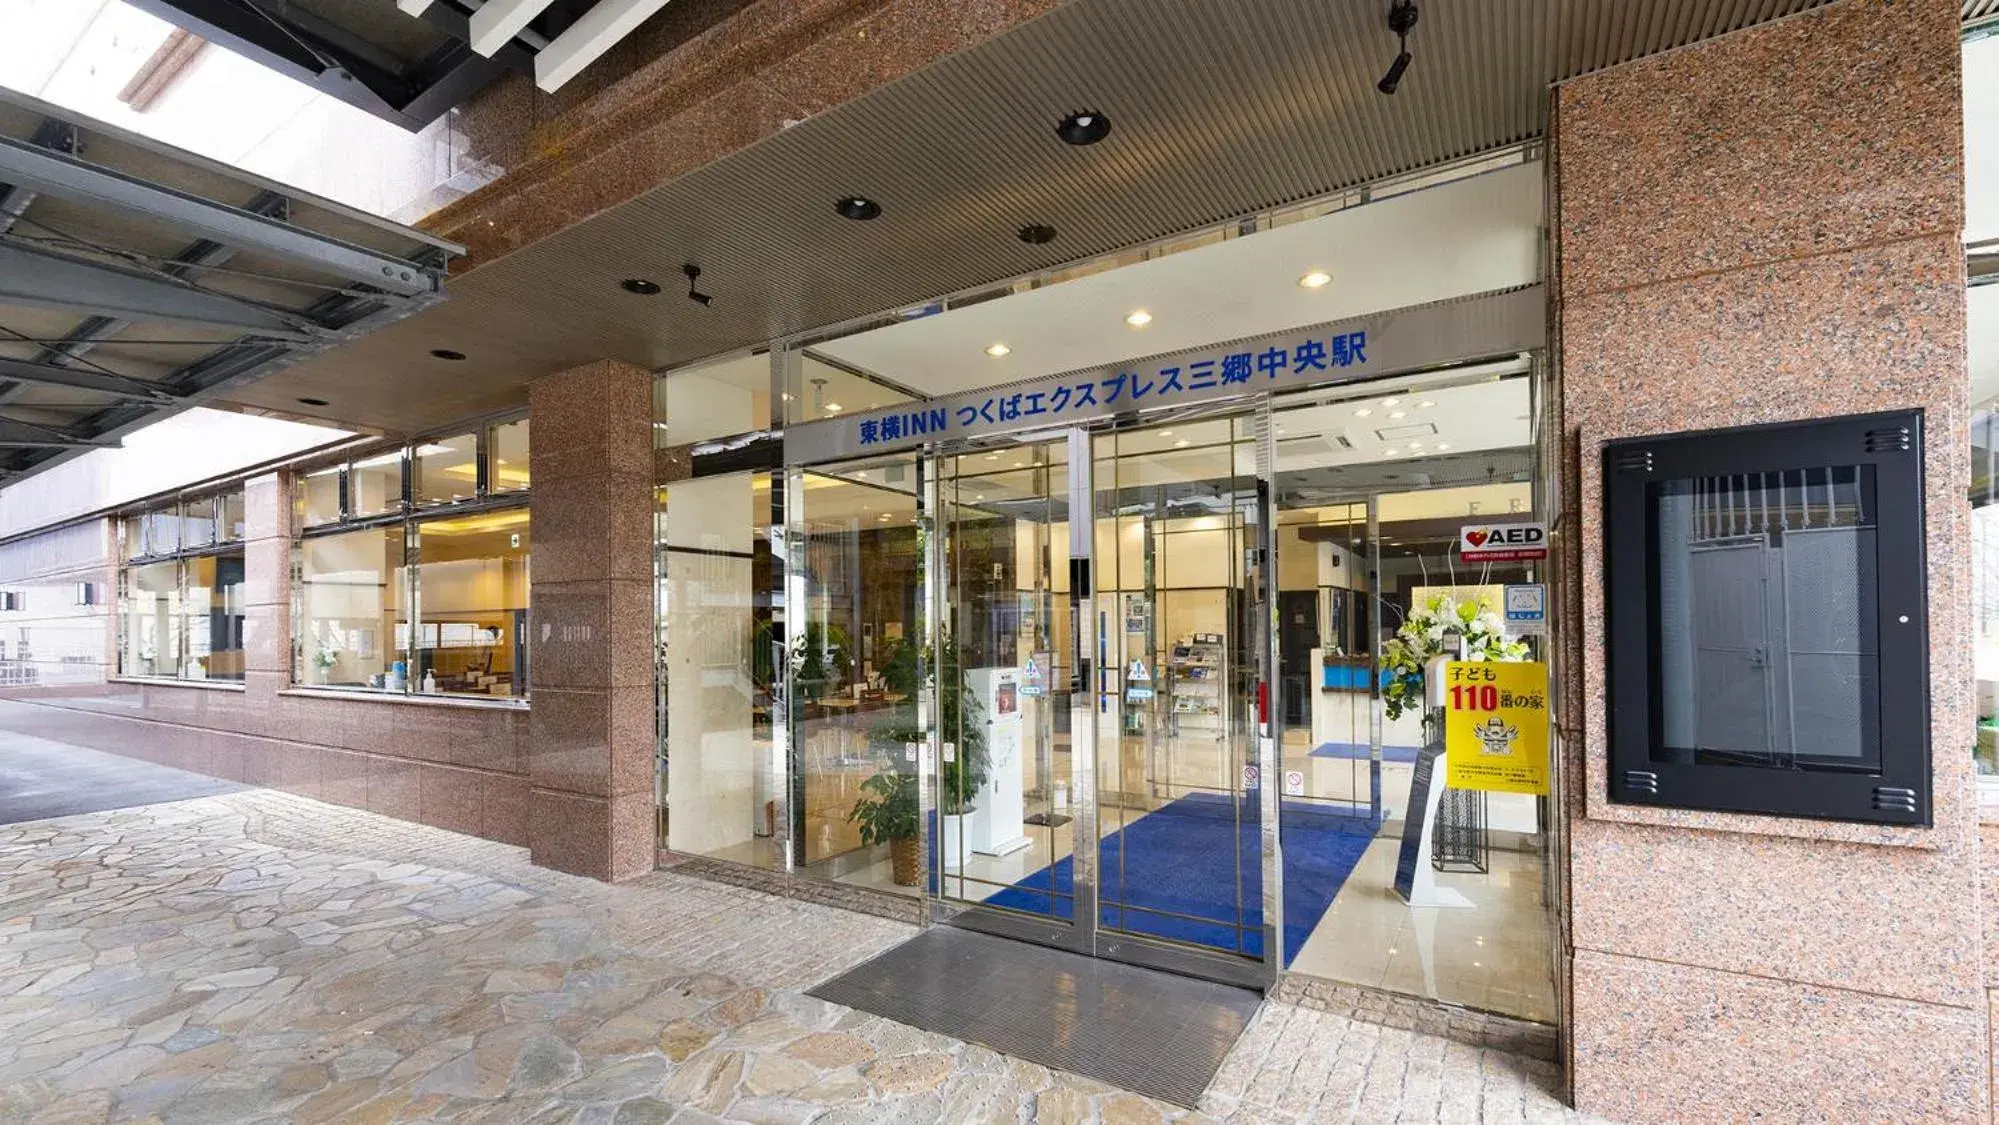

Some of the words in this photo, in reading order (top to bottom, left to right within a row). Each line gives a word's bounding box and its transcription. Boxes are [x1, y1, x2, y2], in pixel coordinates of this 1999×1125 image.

[859, 408, 946, 444] 東横INN
[956, 331, 1368, 427] つくばエクスプレス三郷中央駅
[1488, 528, 1543, 544] AED
[1450, 667, 1496, 681] 子ども
